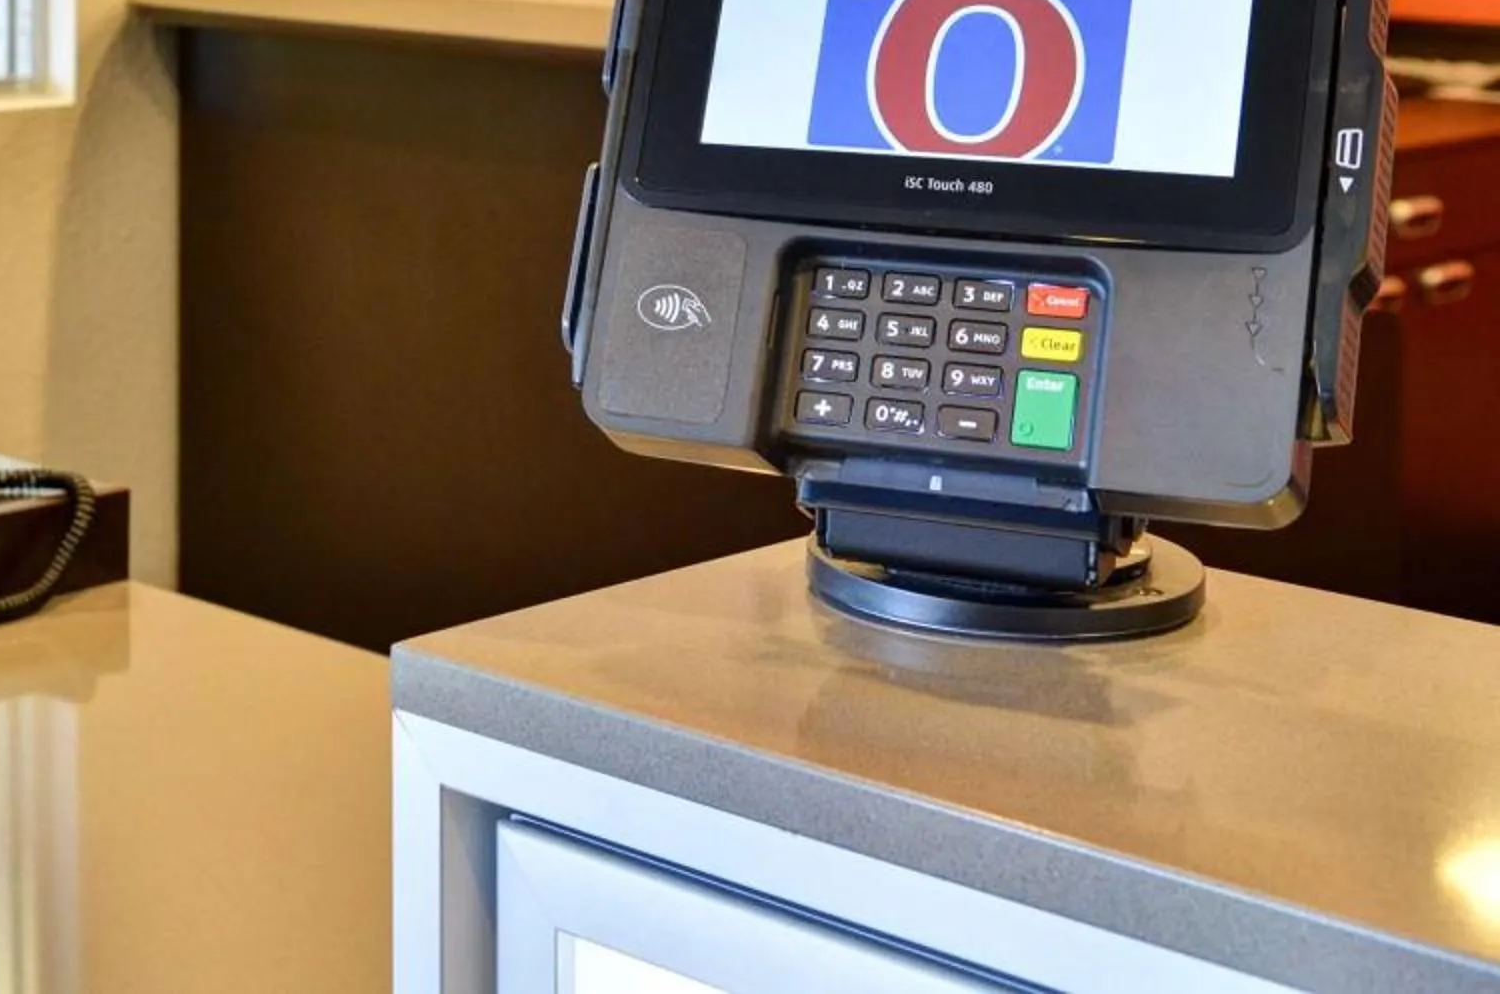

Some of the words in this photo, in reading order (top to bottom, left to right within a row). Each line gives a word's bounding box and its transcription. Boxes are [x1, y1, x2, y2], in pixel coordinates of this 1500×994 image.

[904, 176, 923, 189] iSC
[927, 177, 964, 192] Touch
[968, 181, 993, 194] 480
[825, 275, 834, 291] 1
[892, 280, 904, 296] 2
[912, 285, 935, 297] ABC
[963, 286, 975, 303] 3
[983, 291, 1005, 303] DEF
[816, 314, 830, 331] 4
[886, 320, 899, 337] 5
[955, 328, 969, 345] 6
[973, 333, 1001, 345] MNO
[1041, 338, 1076, 352] Clear
[812, 355, 824, 371] 7
[881, 362, 894, 379] 8
[902, 367, 925, 379] TUV
[951, 369, 964, 386] 9
